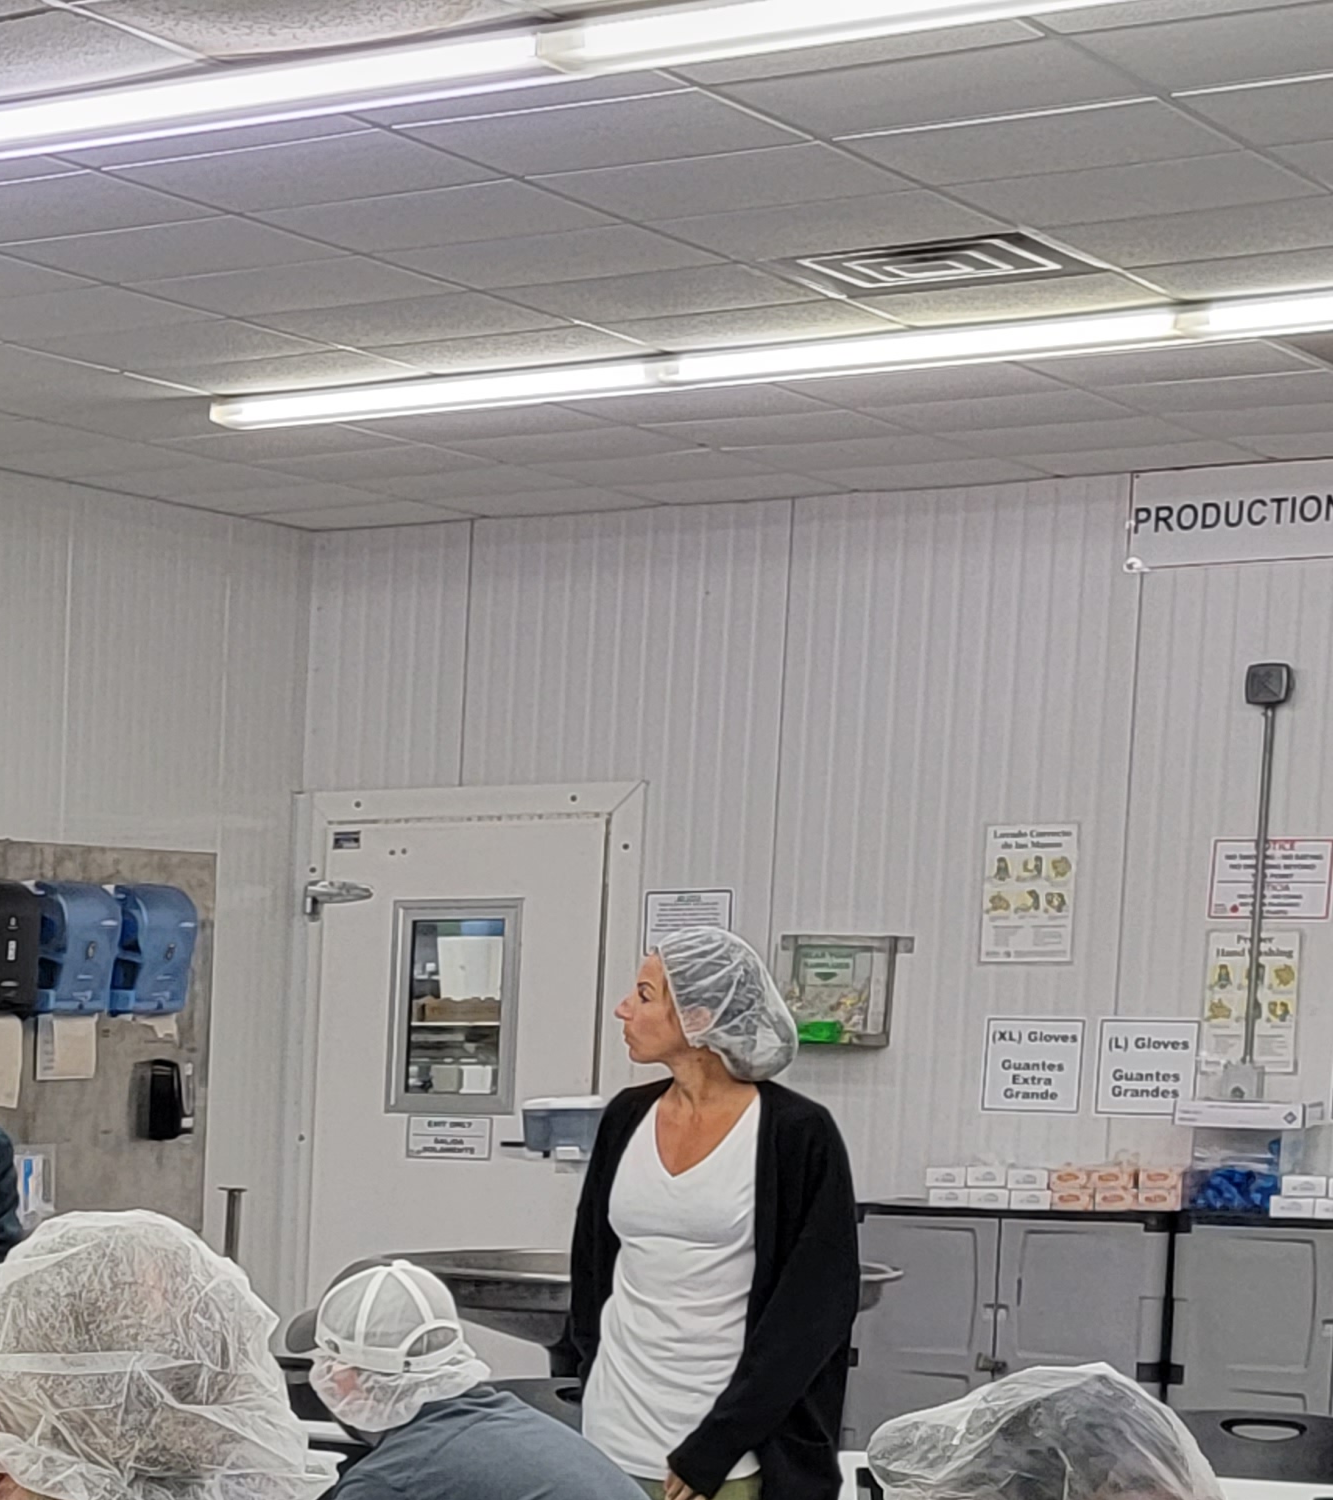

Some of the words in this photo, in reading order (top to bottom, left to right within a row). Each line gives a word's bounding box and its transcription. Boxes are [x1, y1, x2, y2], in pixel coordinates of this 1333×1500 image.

[992, 1030, 1022, 1044] (XL)
[1027, 1031, 1078, 1043] Gloves
[1108, 1037, 1129, 1052] (L)
[1134, 1037, 1190, 1050] Gloves
[1001, 1059, 1065, 1072] Guantes
[1011, 1074, 1053, 1086] Extra
[1112, 1069, 1181, 1083] Guantes
[1003, 1088, 1059, 1100] Grande
[1111, 1085, 1180, 1098] Grandes
